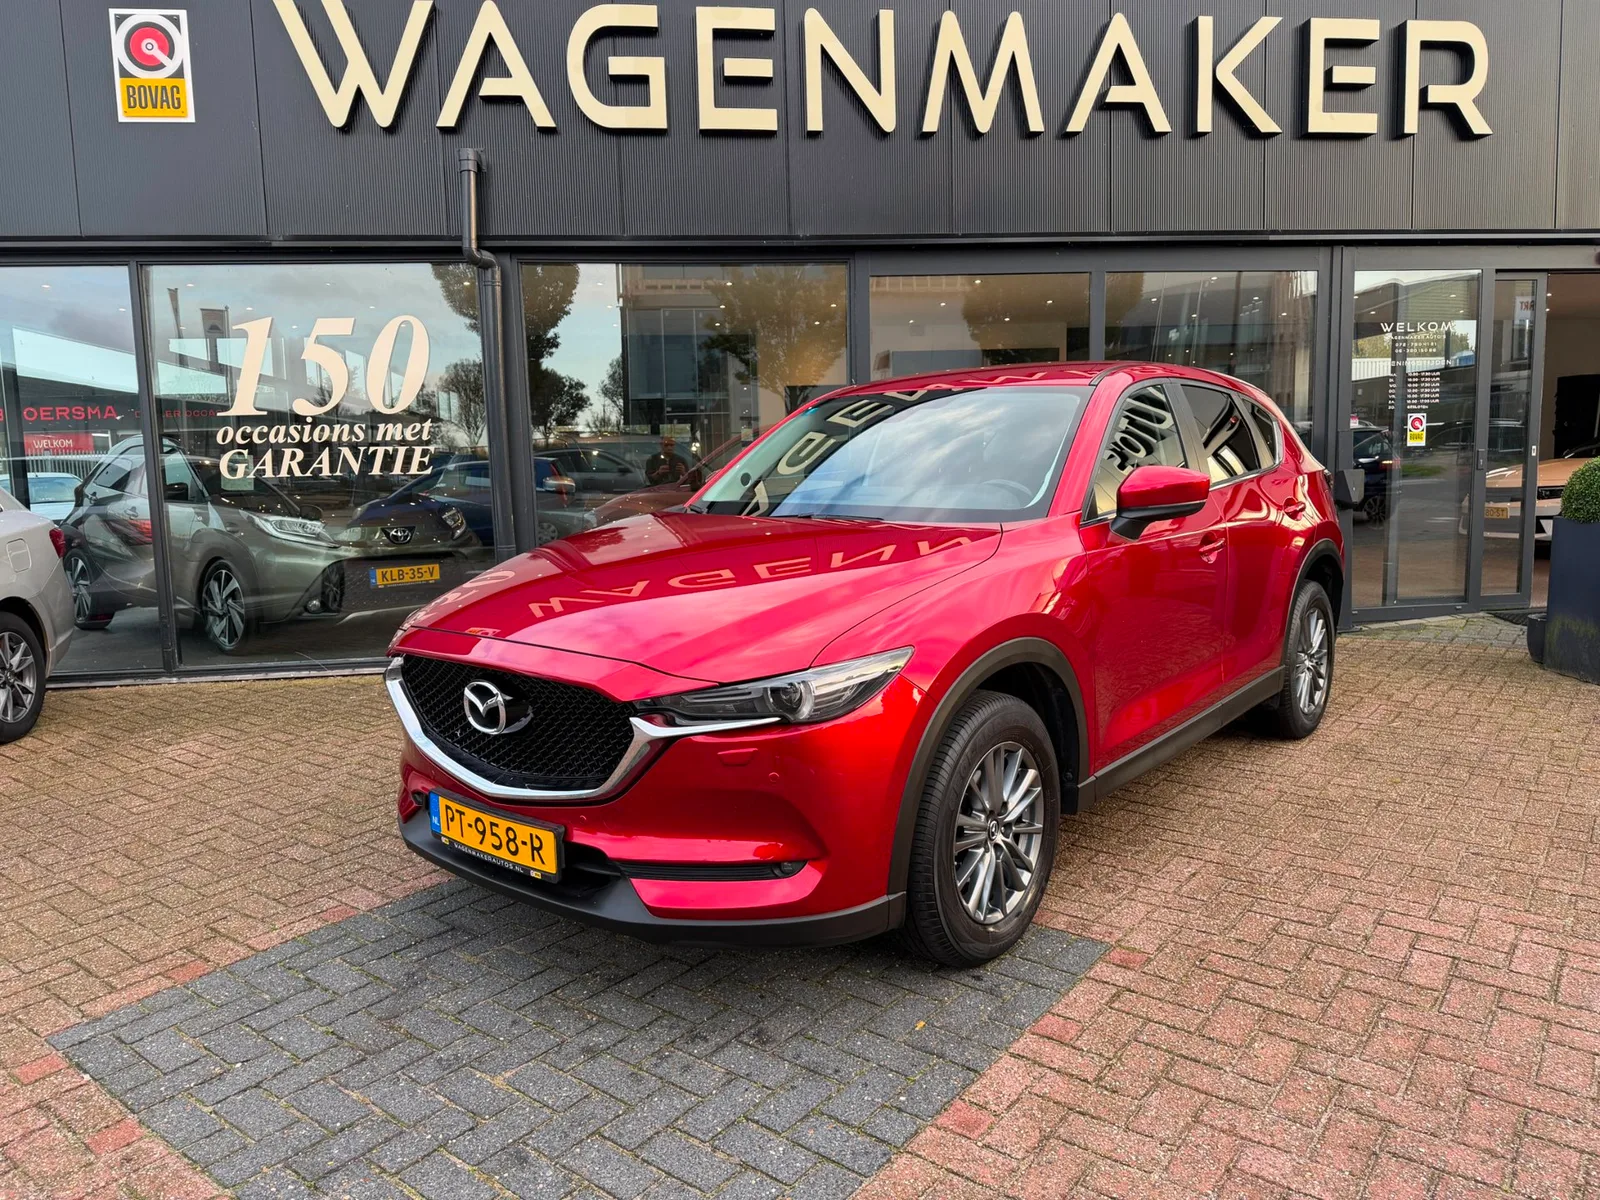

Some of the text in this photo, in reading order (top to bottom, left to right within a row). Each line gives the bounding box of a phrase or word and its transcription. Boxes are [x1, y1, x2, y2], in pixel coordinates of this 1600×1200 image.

[270, 0, 1493, 135] WAGENMAKER
[126, 85, 181, 109] BOVAG
[1380, 321, 1453, 332] WELKOM
[216, 314, 430, 417] 150
[0, 405, 118, 422] OERSMA
[33, 438, 73, 449] WELKOM
[216, 416, 433, 445] occasions met
[219, 446, 436, 480] GARANTIE
[381, 566, 435, 583] KLB-35-V
[445, 804, 546, 865] PT-958-R
[453, 842, 524, 873] WAGENMAKERAUTOS.NL
